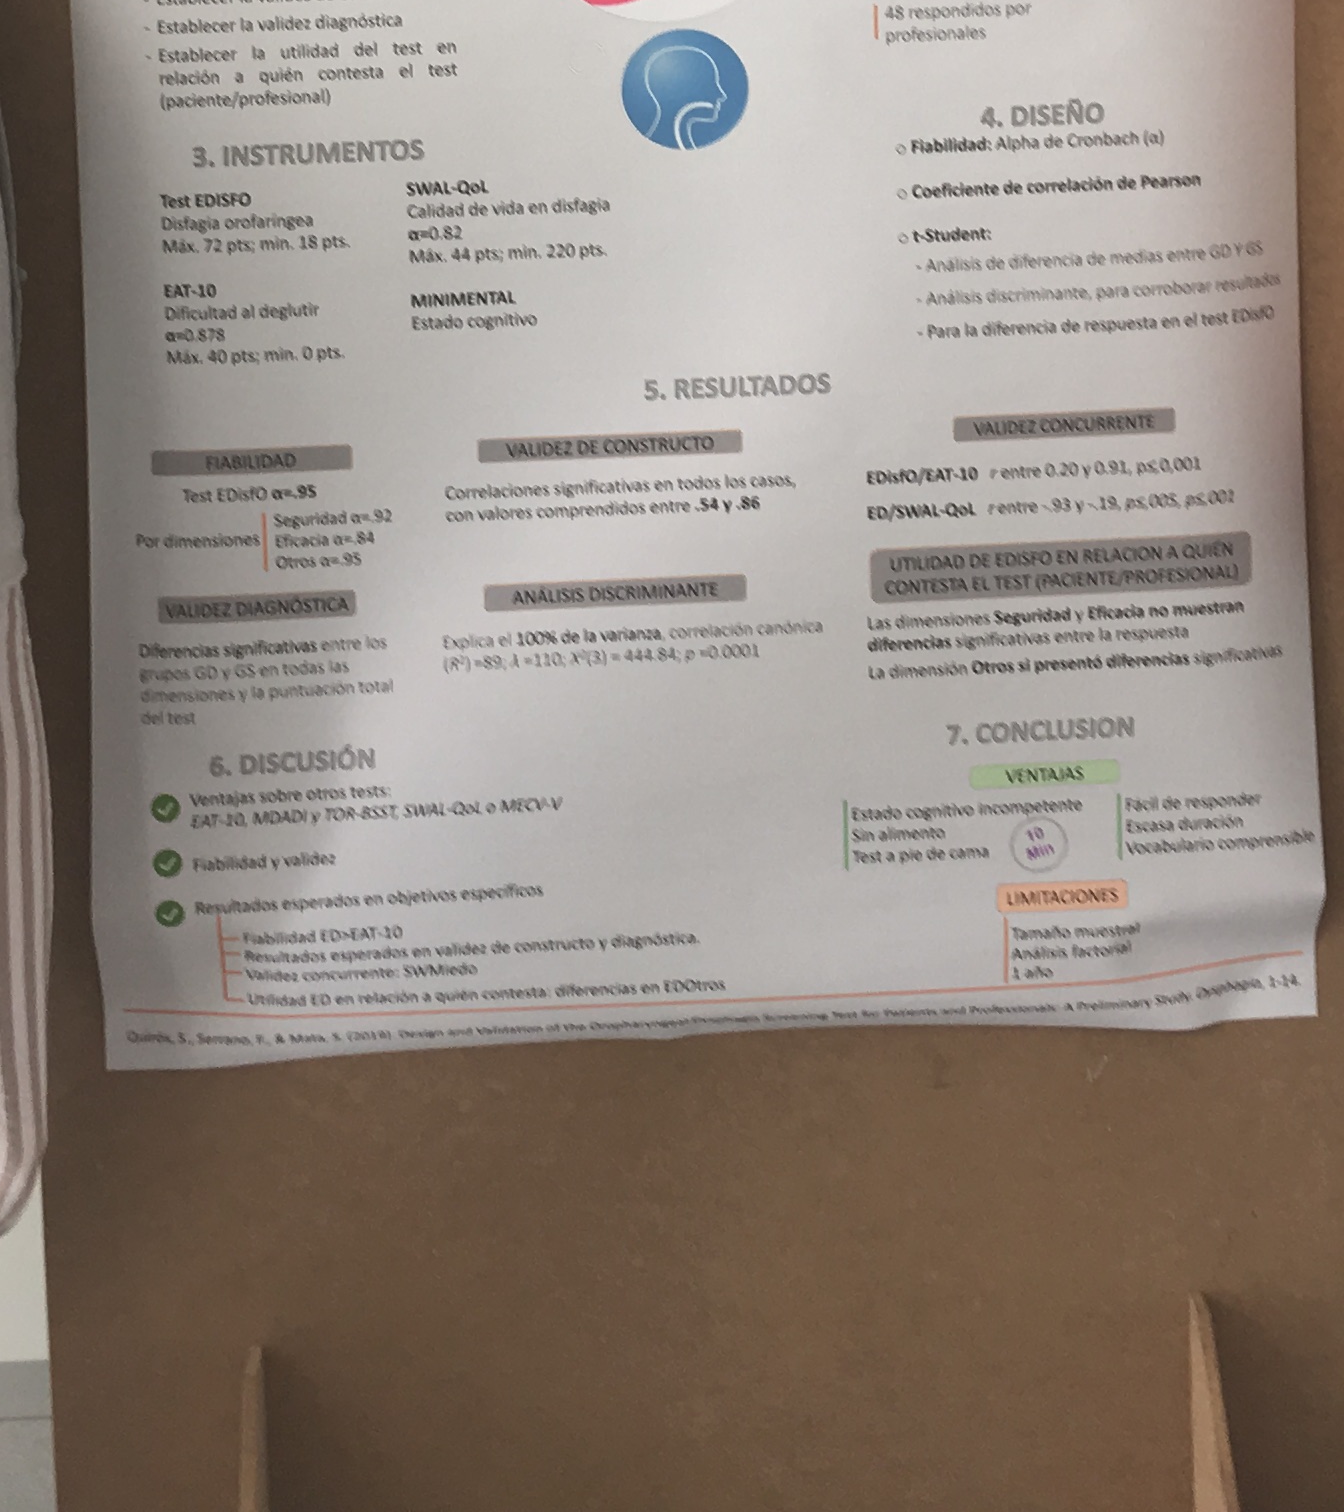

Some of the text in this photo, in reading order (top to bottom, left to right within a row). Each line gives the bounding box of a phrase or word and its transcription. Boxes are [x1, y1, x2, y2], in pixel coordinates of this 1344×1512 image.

[980, 99, 1104, 129] 4. DISEÑO
[192, 139, 424, 169] 3. INSTRUMENTOS
[912, 136, 992, 154] Fiabilidad:
[997, 136, 1040, 152] Alpha
[1045, 135, 1063, 149] de
[1068, 132, 1139, 148] Cronbach
[912, 175, 1201, 199] Coeficiente de correlación de Pearson
[158, 194, 192, 208] Test
[163, 284, 217, 298] EAT-10
[410, 291, 517, 307] MINIMENTAL
[411, 312, 538, 331] Estado cognitivo
[645, 372, 830, 402] 5. RESULTADOS
[241, 744, 374, 775] DISCUSIÓN
